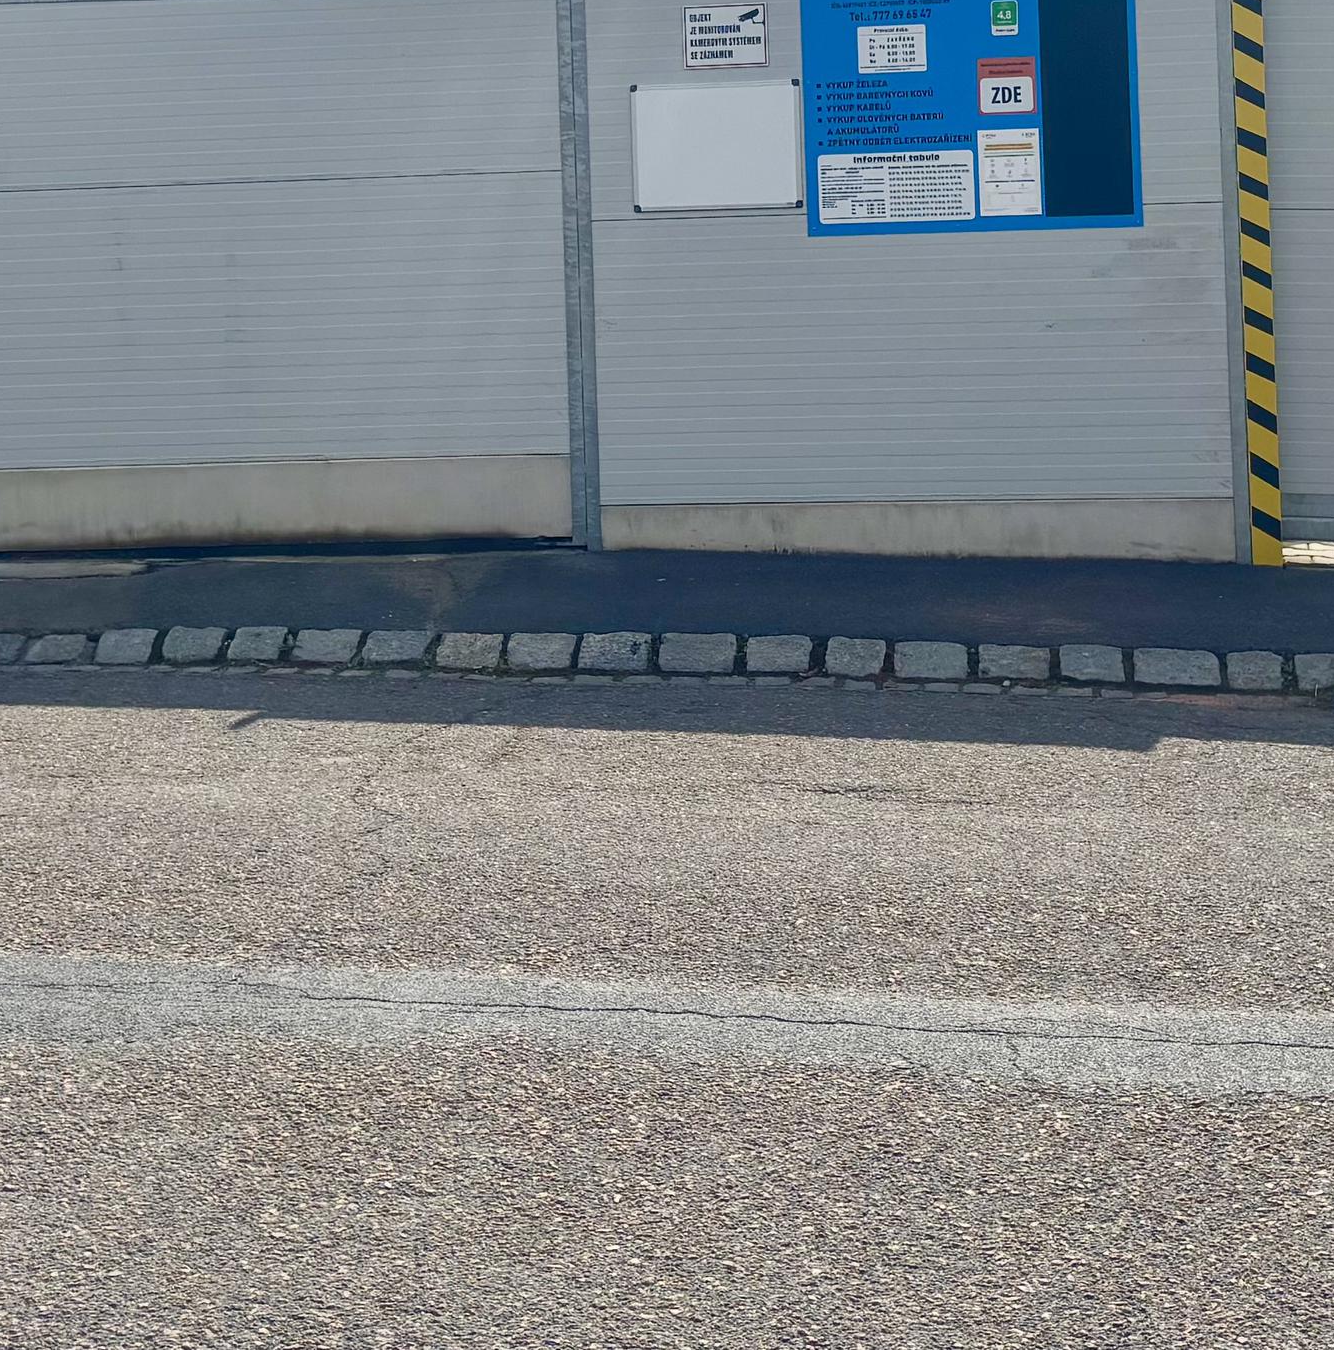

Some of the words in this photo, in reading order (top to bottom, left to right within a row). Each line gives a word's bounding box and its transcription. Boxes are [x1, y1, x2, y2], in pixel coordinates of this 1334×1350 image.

[690, 14, 711, 22] OBJEKT
[873, 11, 890, 21] 777
[893, 10, 903, 20] 69
[920, 8, 932, 18] 47
[690, 26, 697, 34] JE
[699, 24, 740, 34] MONITOROVÁN
[729, 36, 761, 46] SYSTÉMEM
[700, 50, 733, 59] ZÁZNAMEM
[991, 86, 1022, 104] ZDE
[853, 154, 906, 164] Informační
[908, 154, 940, 162] tabule
